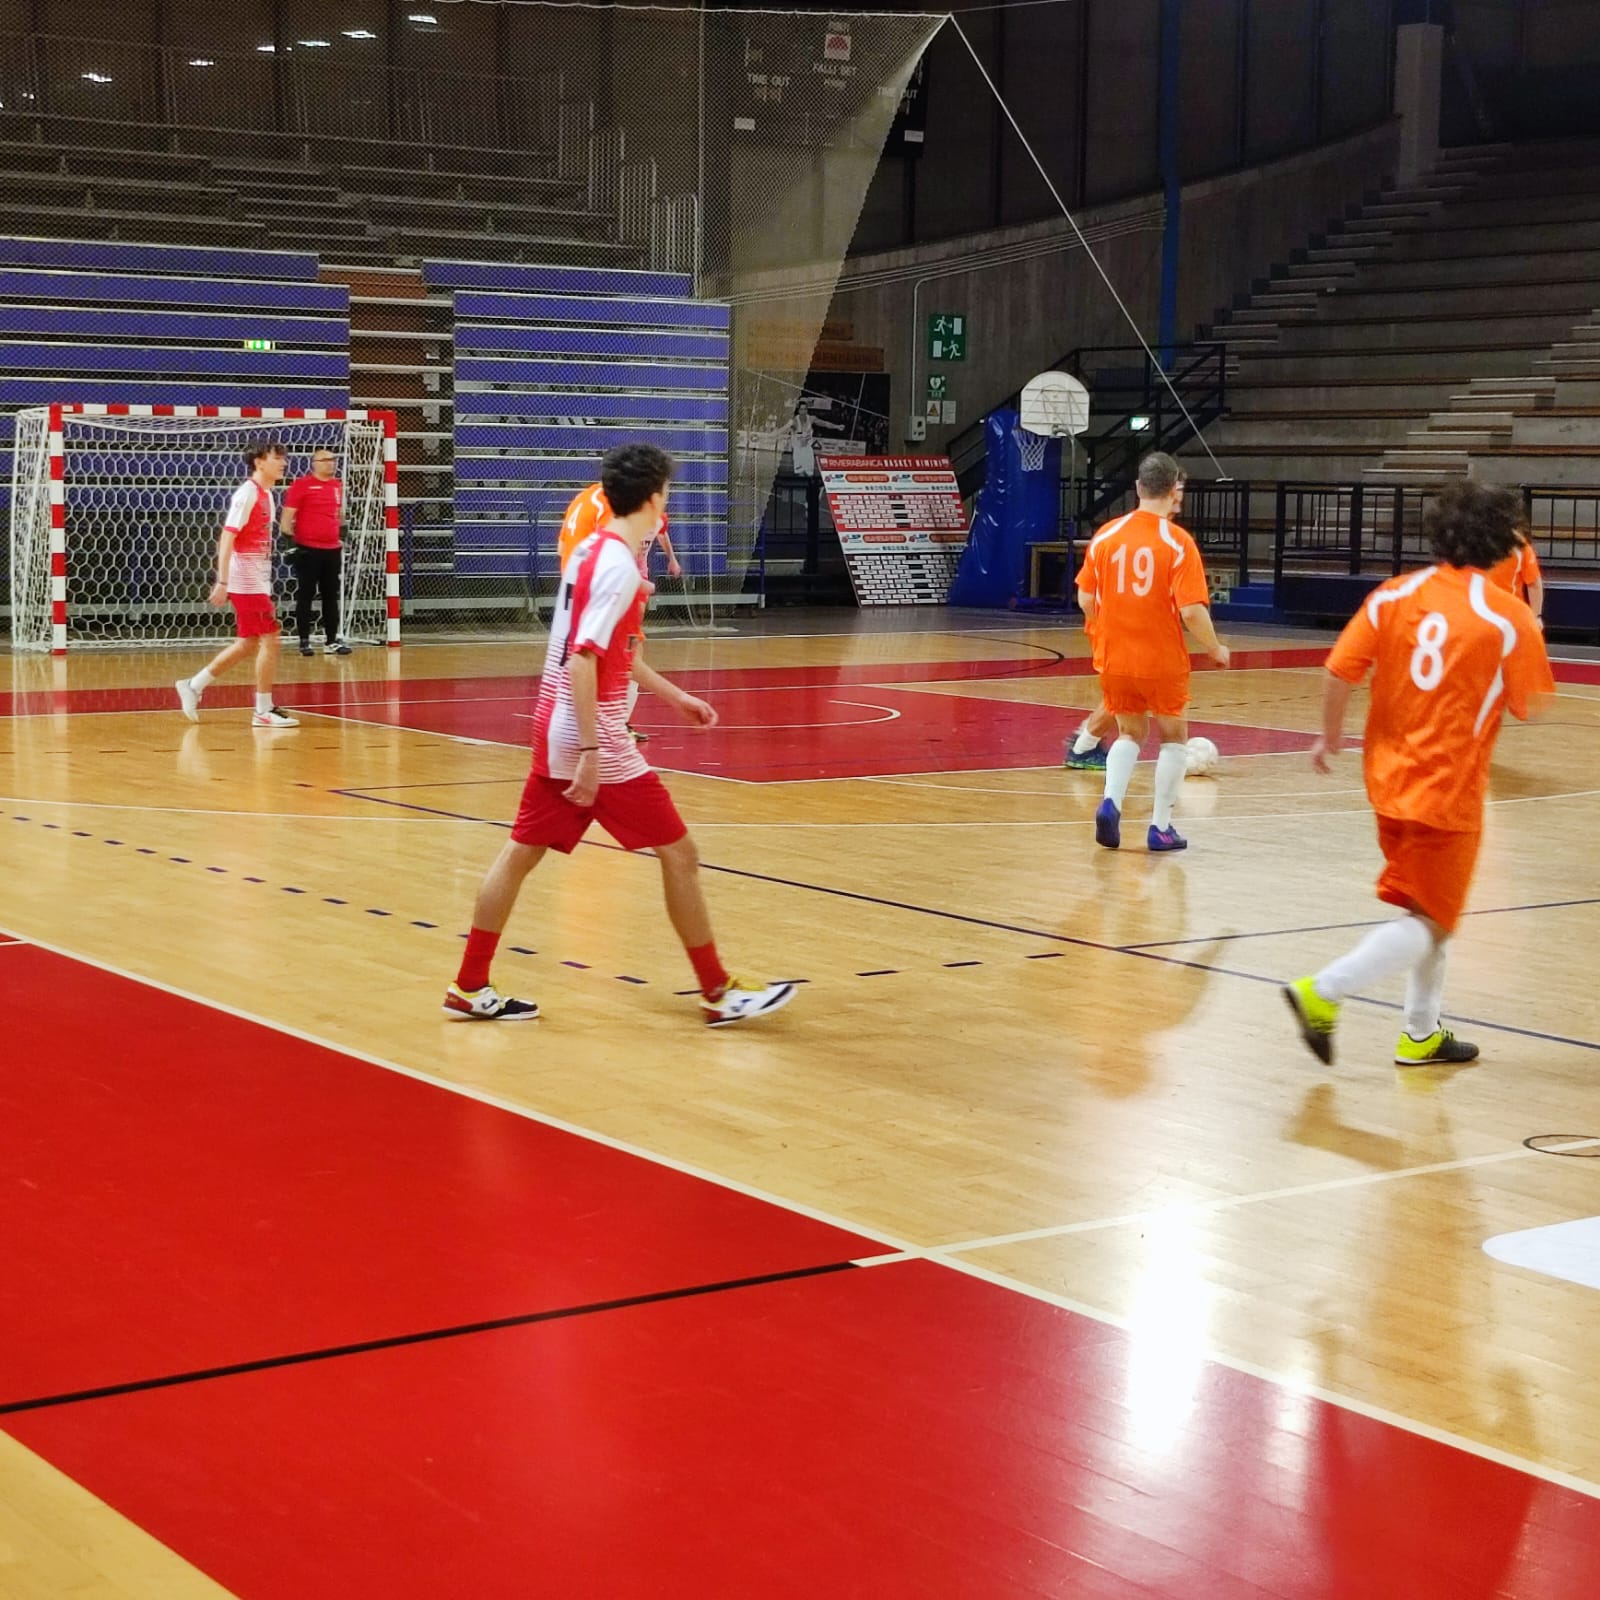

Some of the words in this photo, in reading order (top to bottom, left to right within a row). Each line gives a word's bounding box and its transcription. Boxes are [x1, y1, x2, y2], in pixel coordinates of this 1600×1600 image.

[567, 503, 583, 536] 4
[1111, 543, 1155, 597] 19
[1410, 611, 1449, 692] 8
